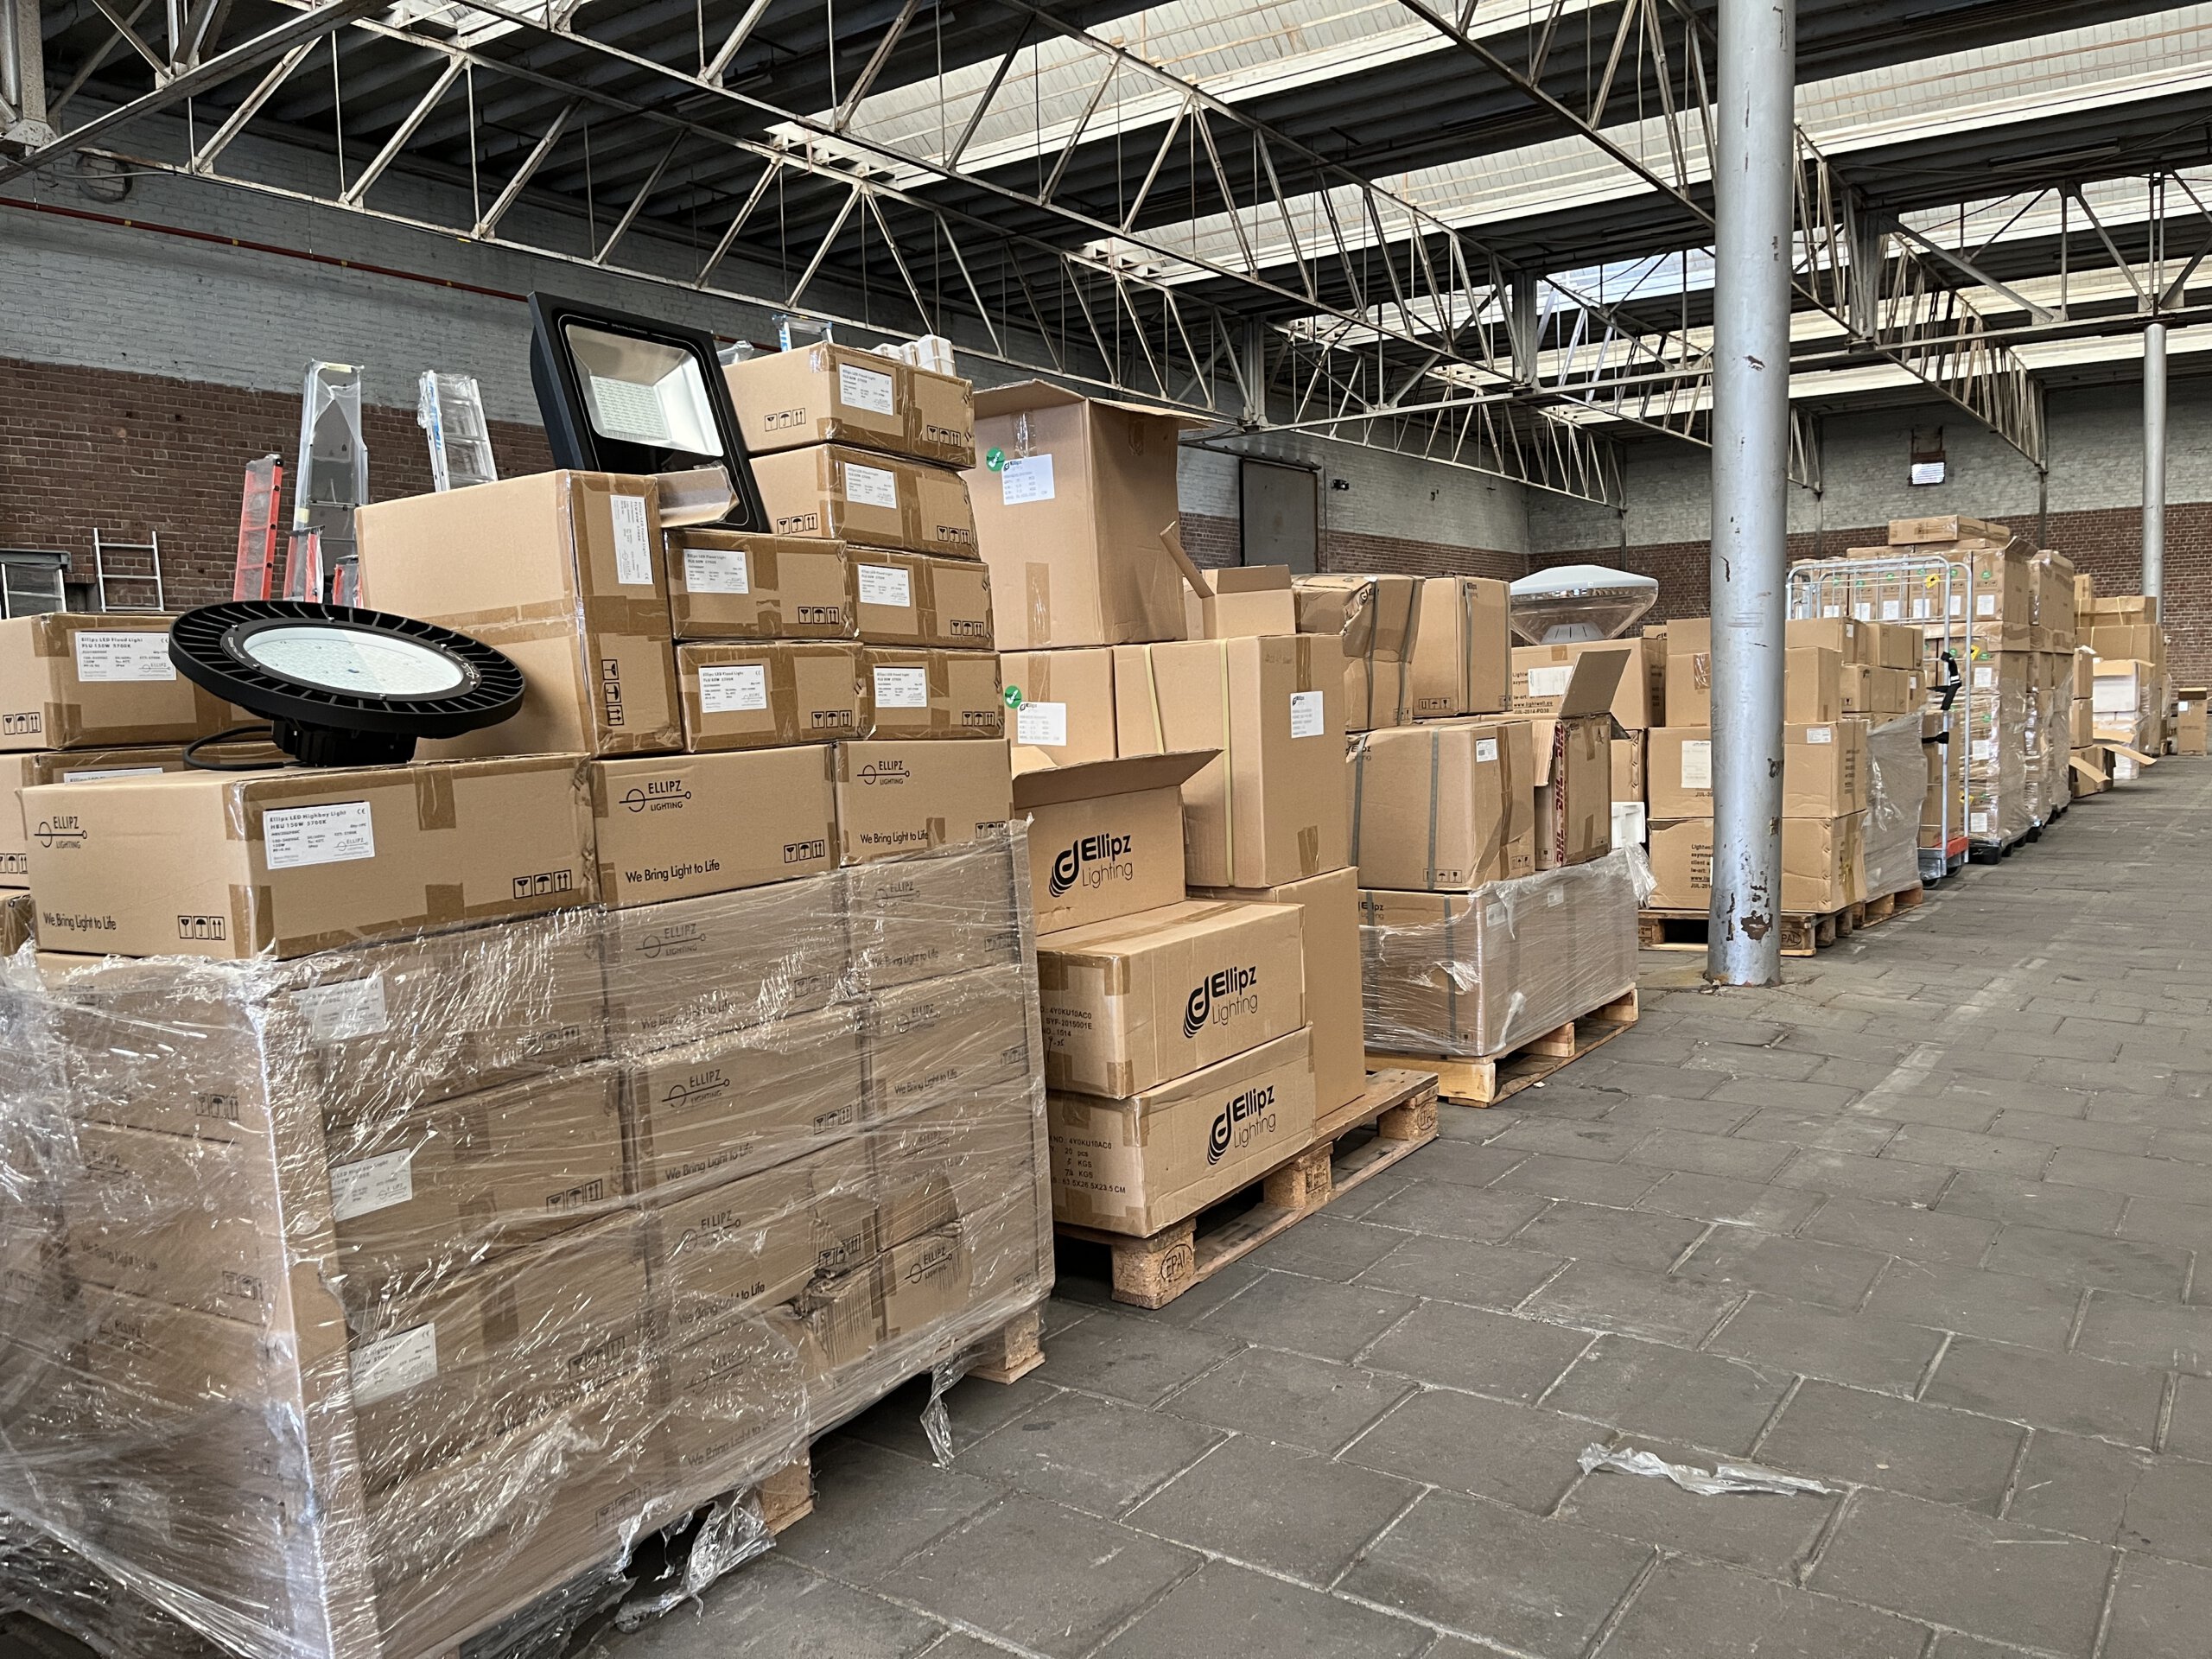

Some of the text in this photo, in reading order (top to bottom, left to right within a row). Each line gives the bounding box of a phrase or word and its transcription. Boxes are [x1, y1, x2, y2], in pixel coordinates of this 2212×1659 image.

[879, 760, 904, 771] ELLIPZ
[648, 780, 682, 794] ELLIPZ
[1555, 777, 1564, 810] DHL
[651, 801, 683, 811] LIGHTING
[53, 816, 79, 830] ELLIPZ
[55, 841, 81, 849] LIGHTING
[860, 830, 929, 845] We Bring Light to Life
[1081, 833, 1132, 861] Ellipz
[1555, 830, 1564, 865] DHL
[626, 859, 720, 883] We Bring Light to Life
[1082, 862, 1133, 889] Lighting
[43, 912, 117, 931] We Bring Light to Life
[664, 924, 696, 939] ELLIPZ
[1211, 966, 1257, 998] Ellipz
[1212, 994, 1258, 1026] Lighting
[690, 1069, 721, 1088] ELLIPZ
[894, 1085, 906, 1095] We
[1233, 1085, 1274, 1122] Ellipz
[1234, 1113, 1276, 1148] Lighting
[665, 1166, 681, 1180] We
[683, 1160, 706, 1176] Bring
[708, 1152, 728, 1169] Light
[740, 1142, 753, 1157] Life
[1078, 1170, 1093, 1179] KGS
[924, 1246, 945, 1264] ELLIPZ
[741, 1290, 749, 1300] to
[751, 1281, 766, 1297] Life
